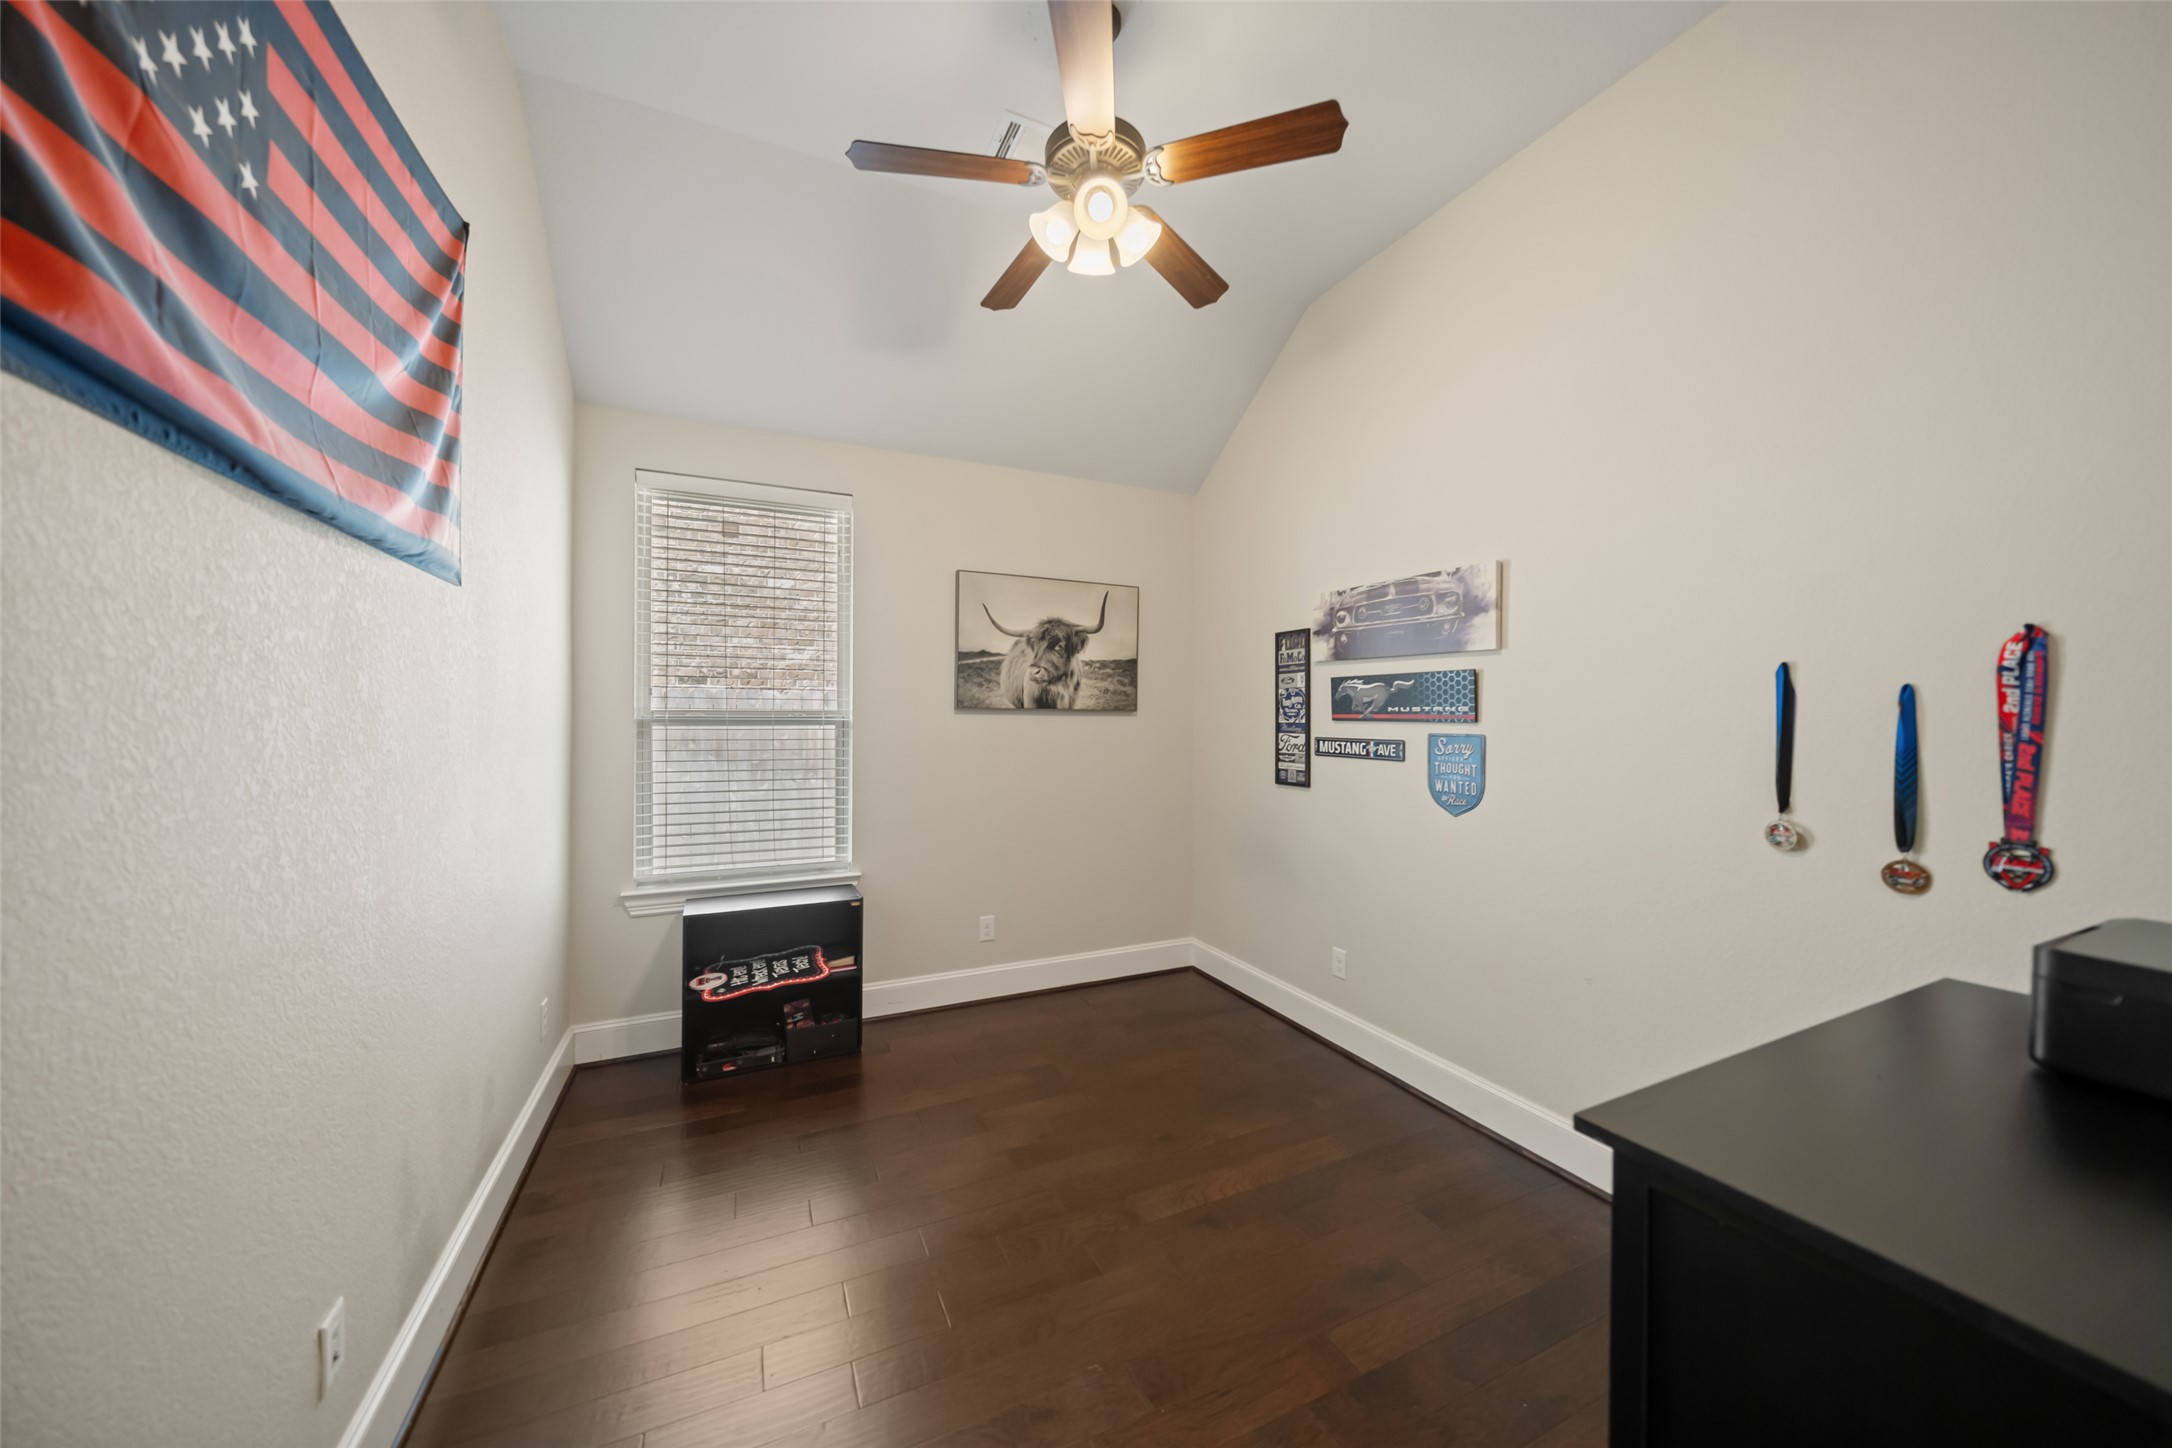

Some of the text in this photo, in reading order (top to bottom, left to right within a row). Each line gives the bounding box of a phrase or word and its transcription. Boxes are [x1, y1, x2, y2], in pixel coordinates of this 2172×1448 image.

[2001, 640, 2023, 686] PLACE
[1279, 733, 1306, 753] Ford
[1319, 740, 1396, 757] MUSTANG AVE
[1434, 737, 1474, 759] Sorry
[1434, 762, 1477, 778] THOUGHT
[1435, 779, 1477, 796] WANTED
[1446, 794, 1468, 805] Race
